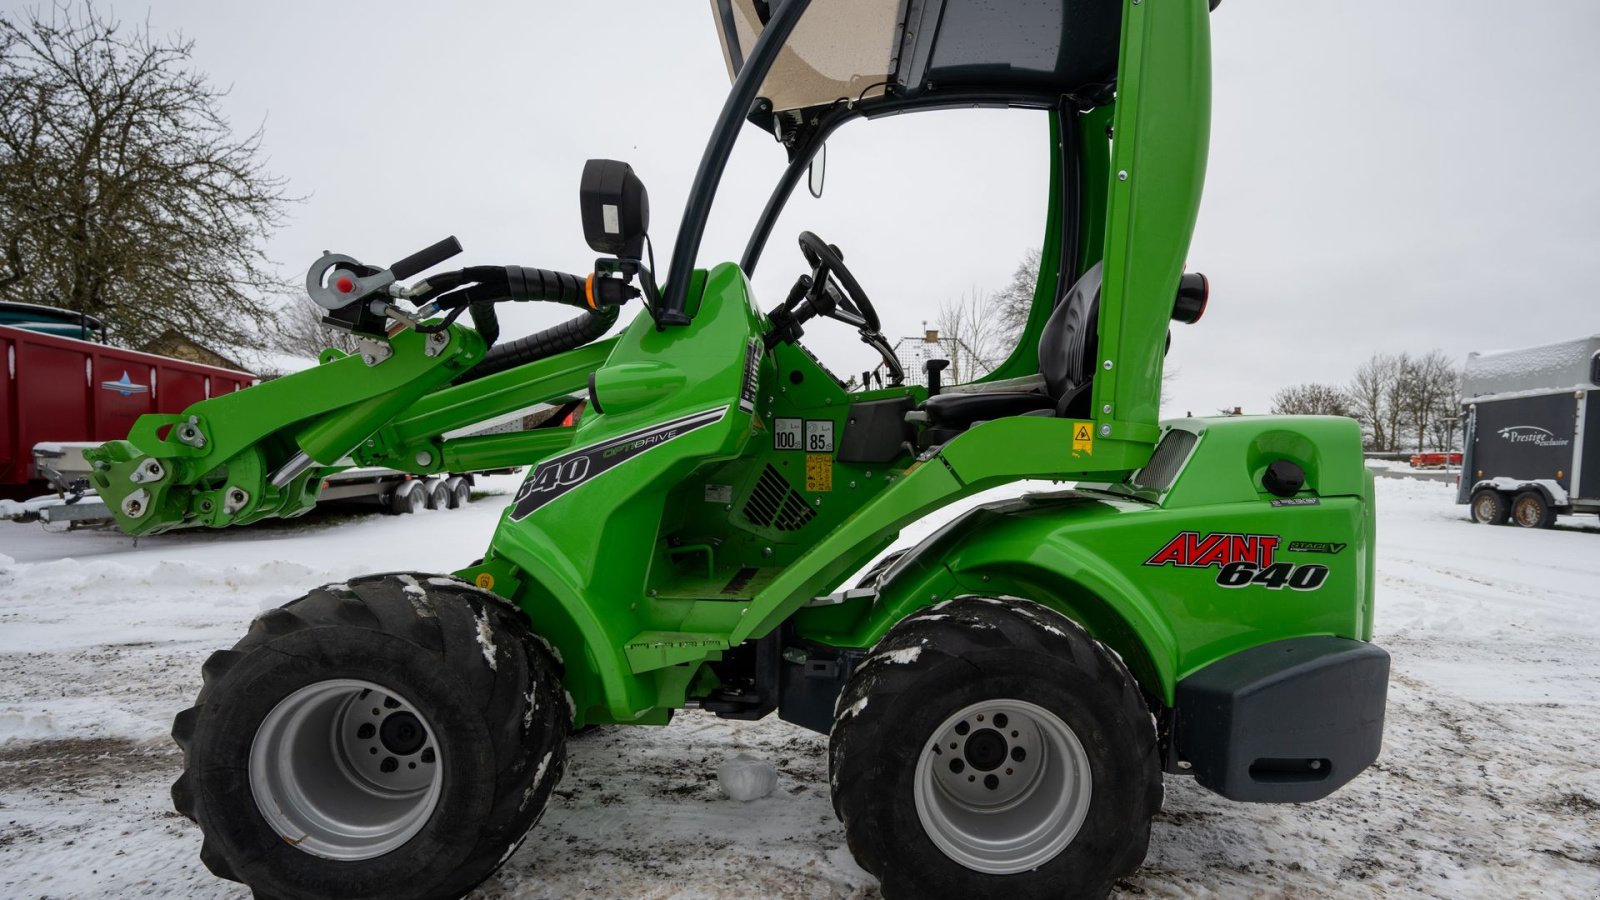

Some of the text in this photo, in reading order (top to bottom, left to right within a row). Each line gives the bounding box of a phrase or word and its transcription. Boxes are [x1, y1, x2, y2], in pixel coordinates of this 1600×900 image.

[603, 429, 678, 459] OPTIDRIVE
[776, 432, 795, 448] 100
[810, 434, 826, 450] 85
[1510, 431, 1547, 445] Prestige
[1143, 531, 1281, 571] AVANT
[1215, 561, 1330, 591] 640
